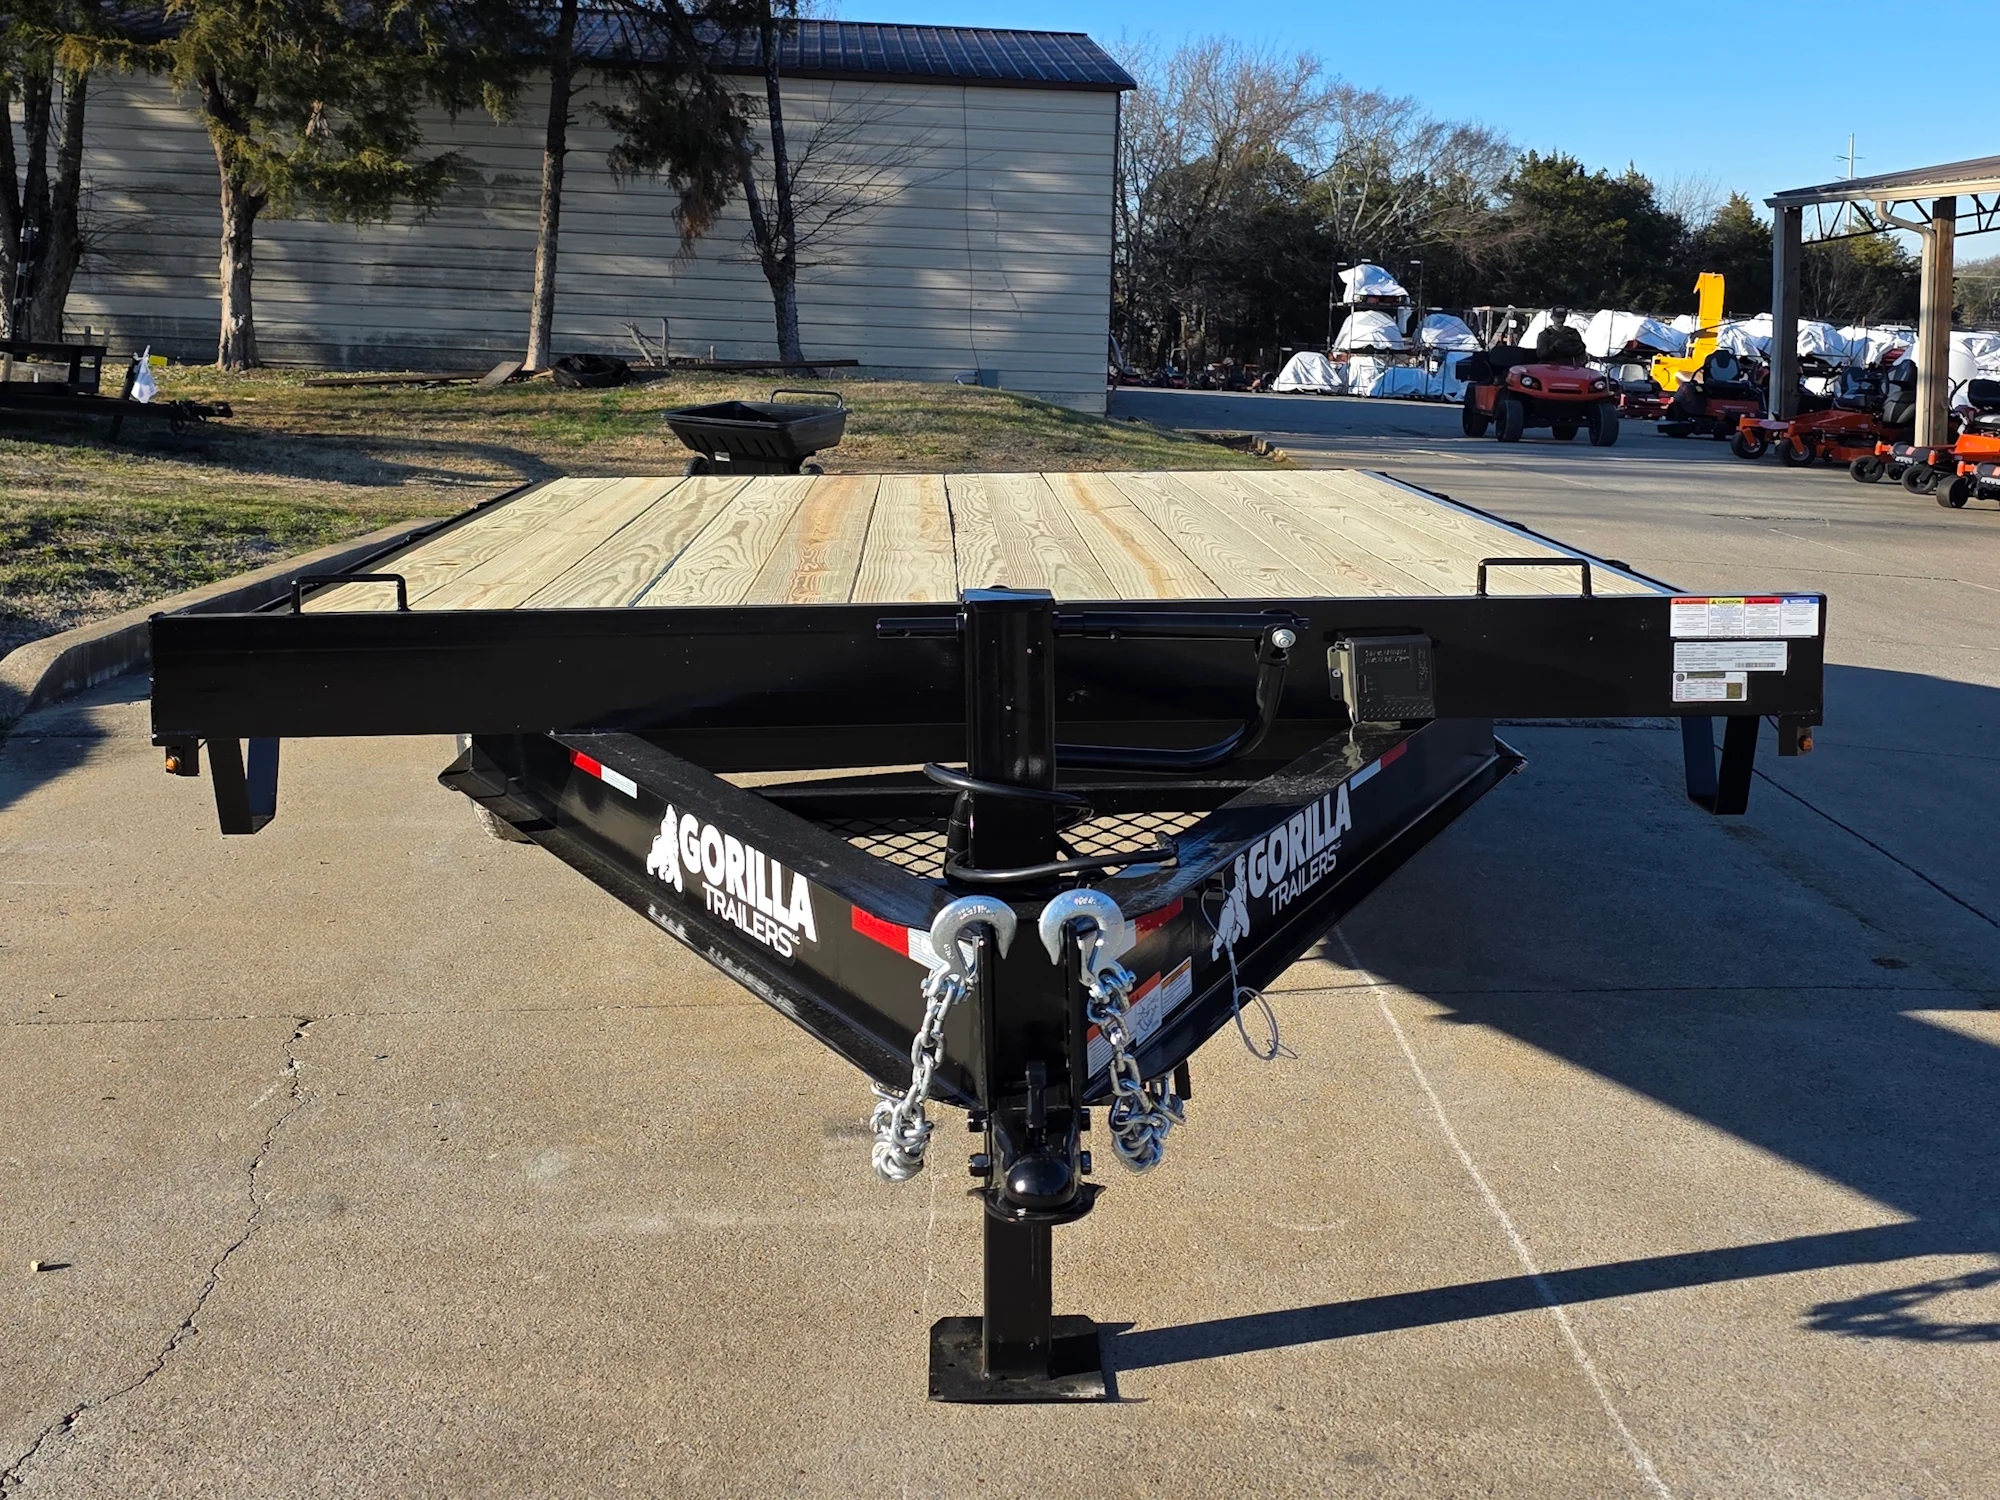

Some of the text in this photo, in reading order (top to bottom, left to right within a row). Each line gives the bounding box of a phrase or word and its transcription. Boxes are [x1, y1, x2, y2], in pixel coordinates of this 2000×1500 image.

[679, 813, 818, 943] GORILLA
[1249, 782, 1352, 898] GORILLA
[1268, 844, 1337, 916] TRAILERS
[702, 881, 793, 958] TRAILERS
